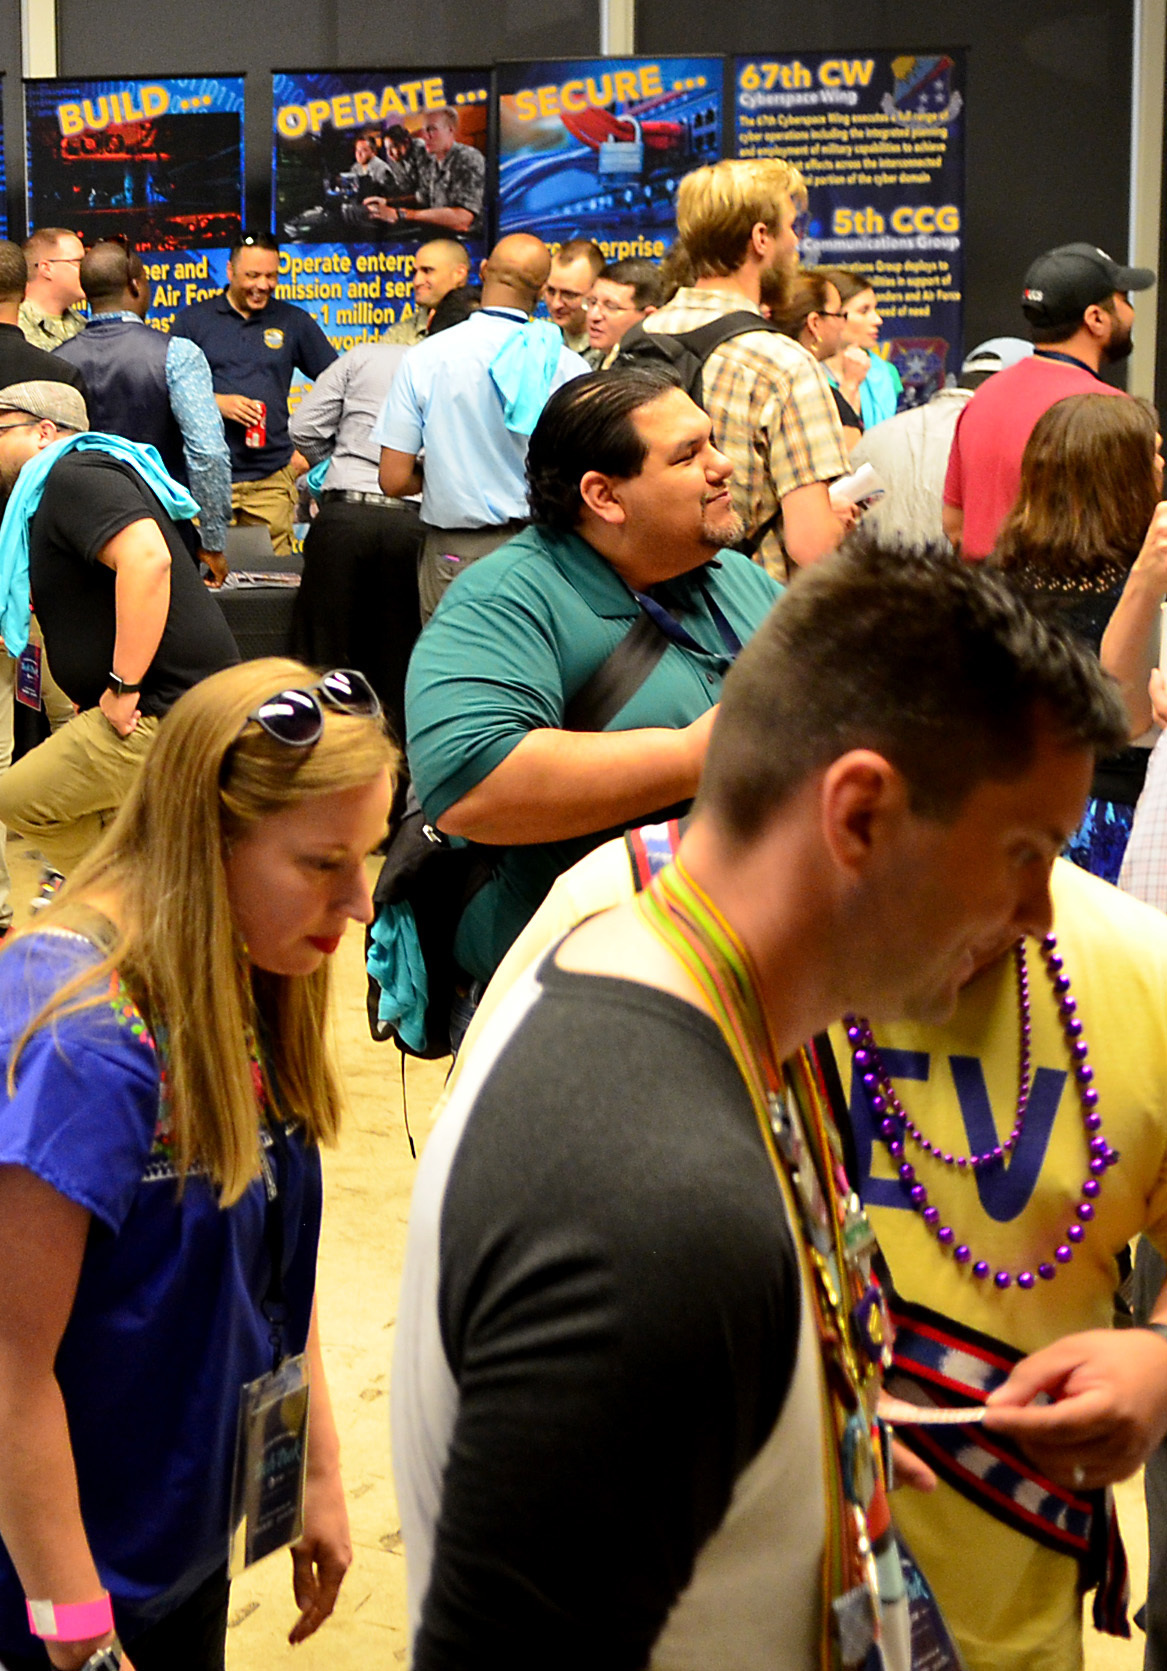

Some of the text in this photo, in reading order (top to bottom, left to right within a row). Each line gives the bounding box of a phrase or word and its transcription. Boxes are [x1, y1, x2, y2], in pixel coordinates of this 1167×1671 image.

[740, 60, 874, 90] 67th CW
[515, 64, 664, 121] SECURE
[820, 89, 858, 106] Wing
[58, 85, 170, 136] BUILD
[277, 77, 447, 136] OPERATE
[834, 205, 960, 234] 5th CCG
[803, 235, 961, 251] Communications Group
[174, 255, 208, 280] and
[278, 251, 351, 278] Operate
[153, 284, 181, 308] Air
[275, 276, 342, 300] mission
[347, 275, 381, 299] and
[320, 304, 330, 325] 1
[336, 302, 396, 326] million
